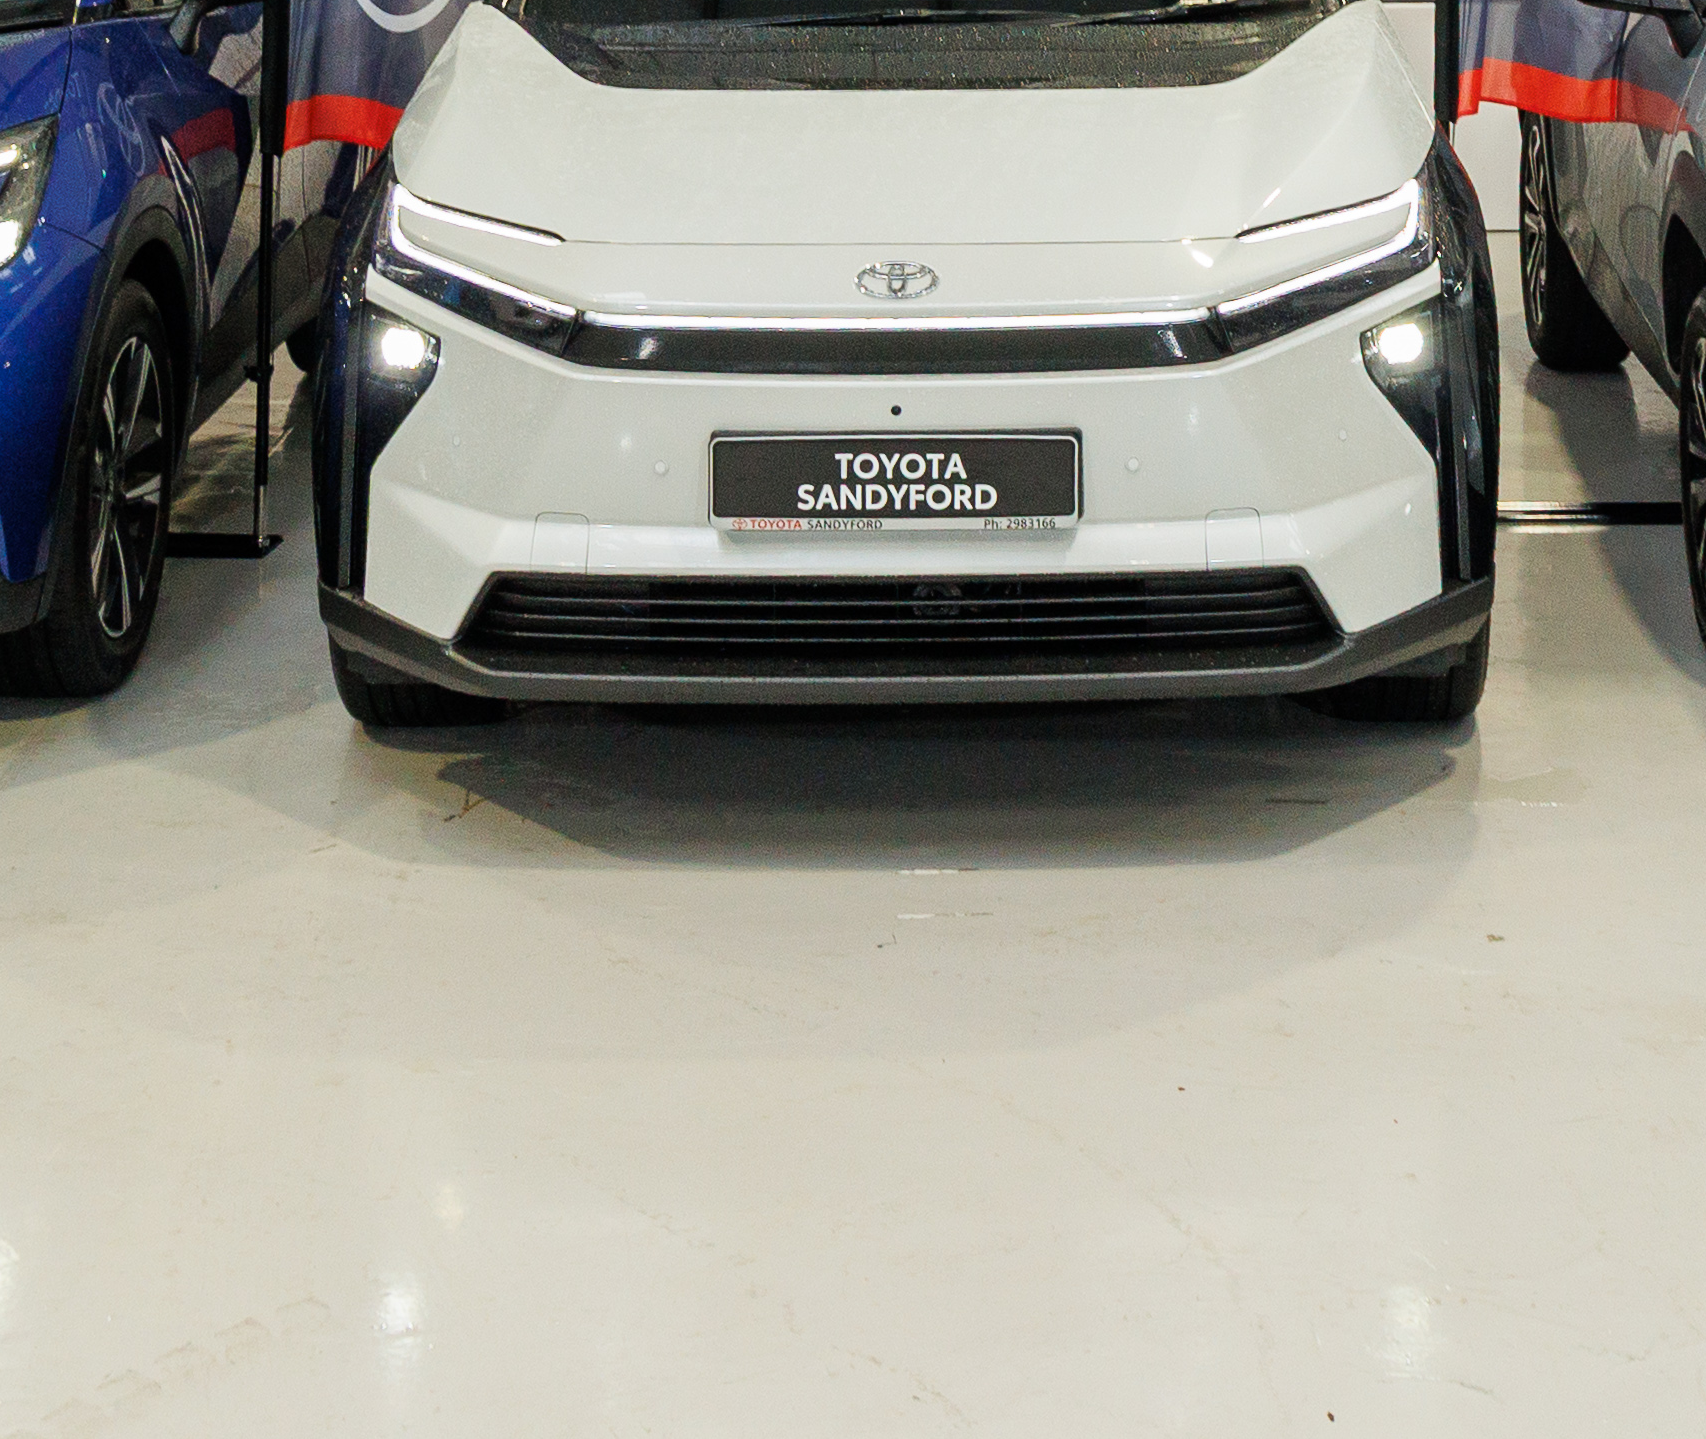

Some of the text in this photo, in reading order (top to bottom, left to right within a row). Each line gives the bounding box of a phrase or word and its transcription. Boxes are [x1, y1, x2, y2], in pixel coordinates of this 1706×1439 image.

[834, 453, 967, 480] TOYOTA
[797, 484, 998, 511] SANDYFORD
[750, 519, 883, 530] TOYOTA SANDYFORD
[984, 518, 1056, 529] Ph: 2983166
